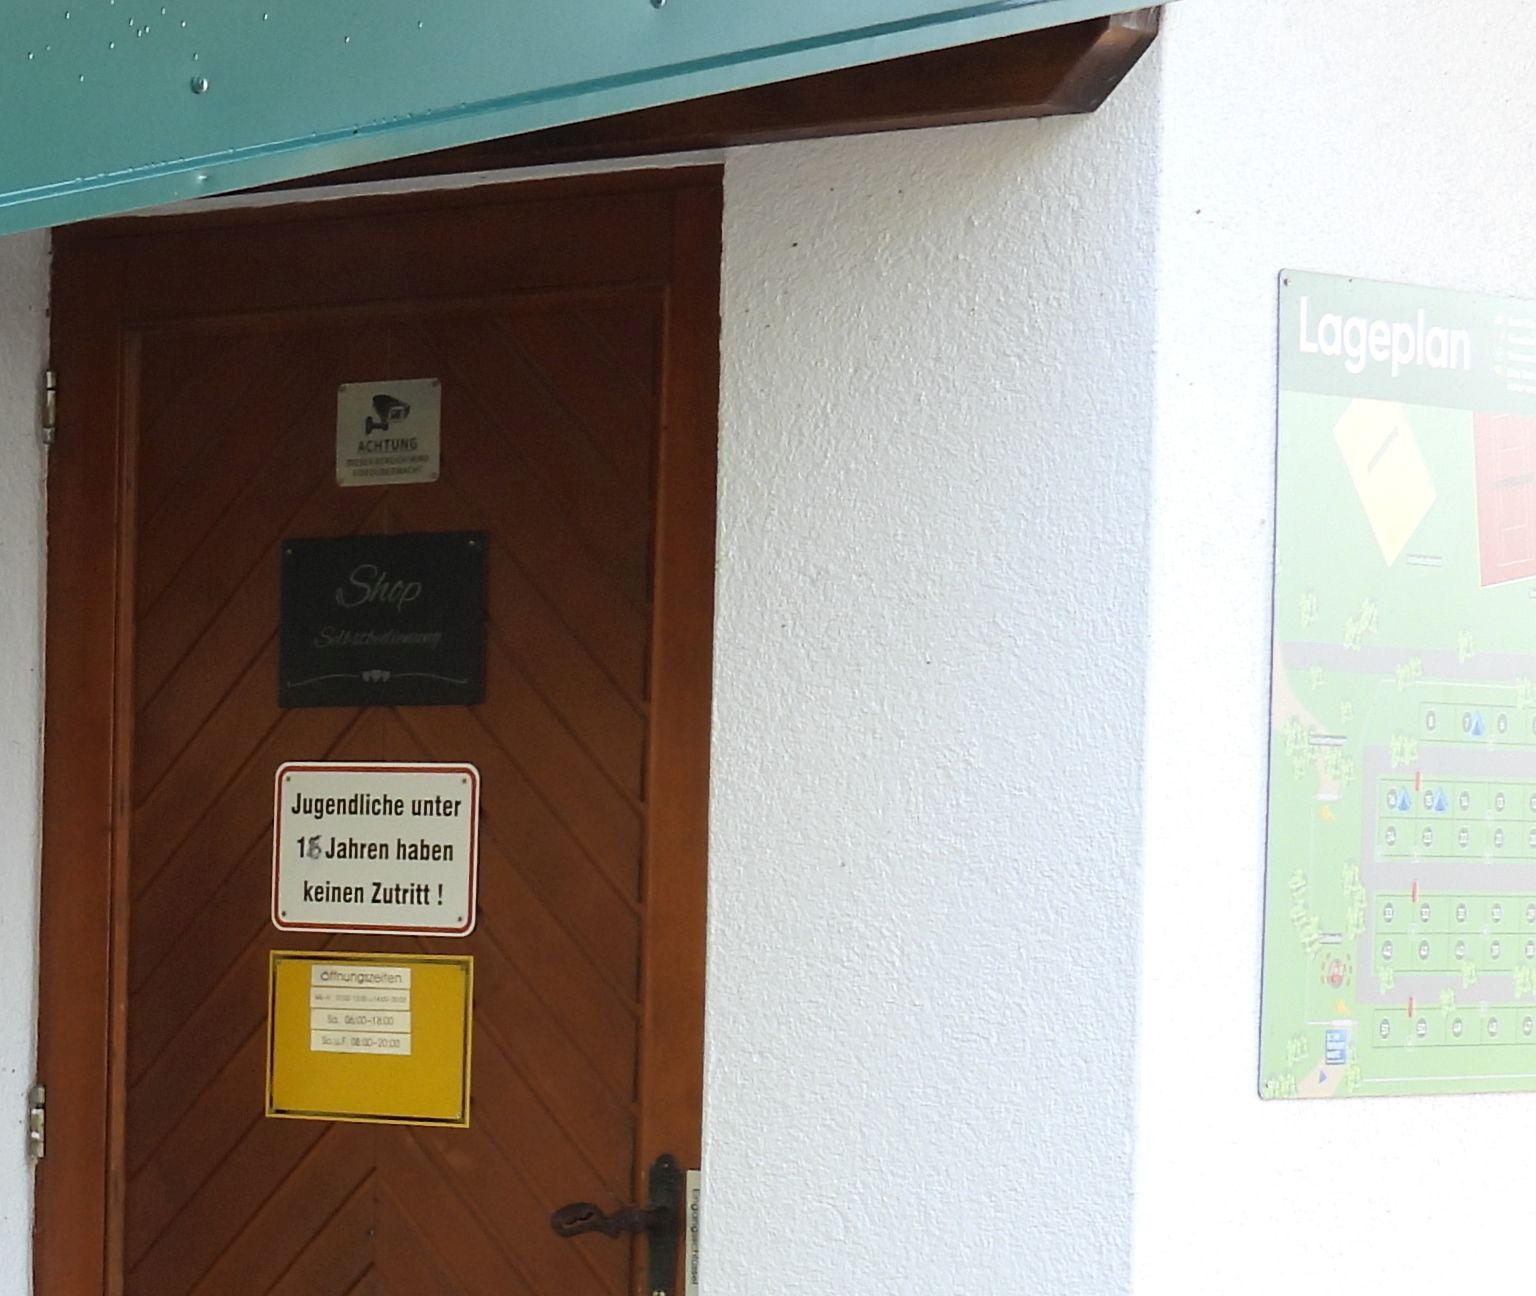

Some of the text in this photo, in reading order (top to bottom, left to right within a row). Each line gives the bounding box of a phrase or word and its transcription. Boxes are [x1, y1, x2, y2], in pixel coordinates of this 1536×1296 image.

[1299, 295, 1471, 377] Lageplan
[357, 437, 418, 454] ACHTUNG
[335, 563, 423, 612] Shop
[291, 793, 462, 819] Jugendliche unter
[325, 838, 389, 860] Jahren
[396, 838, 454, 861] haben
[303, 880, 443, 905] keinen Zutritt !
